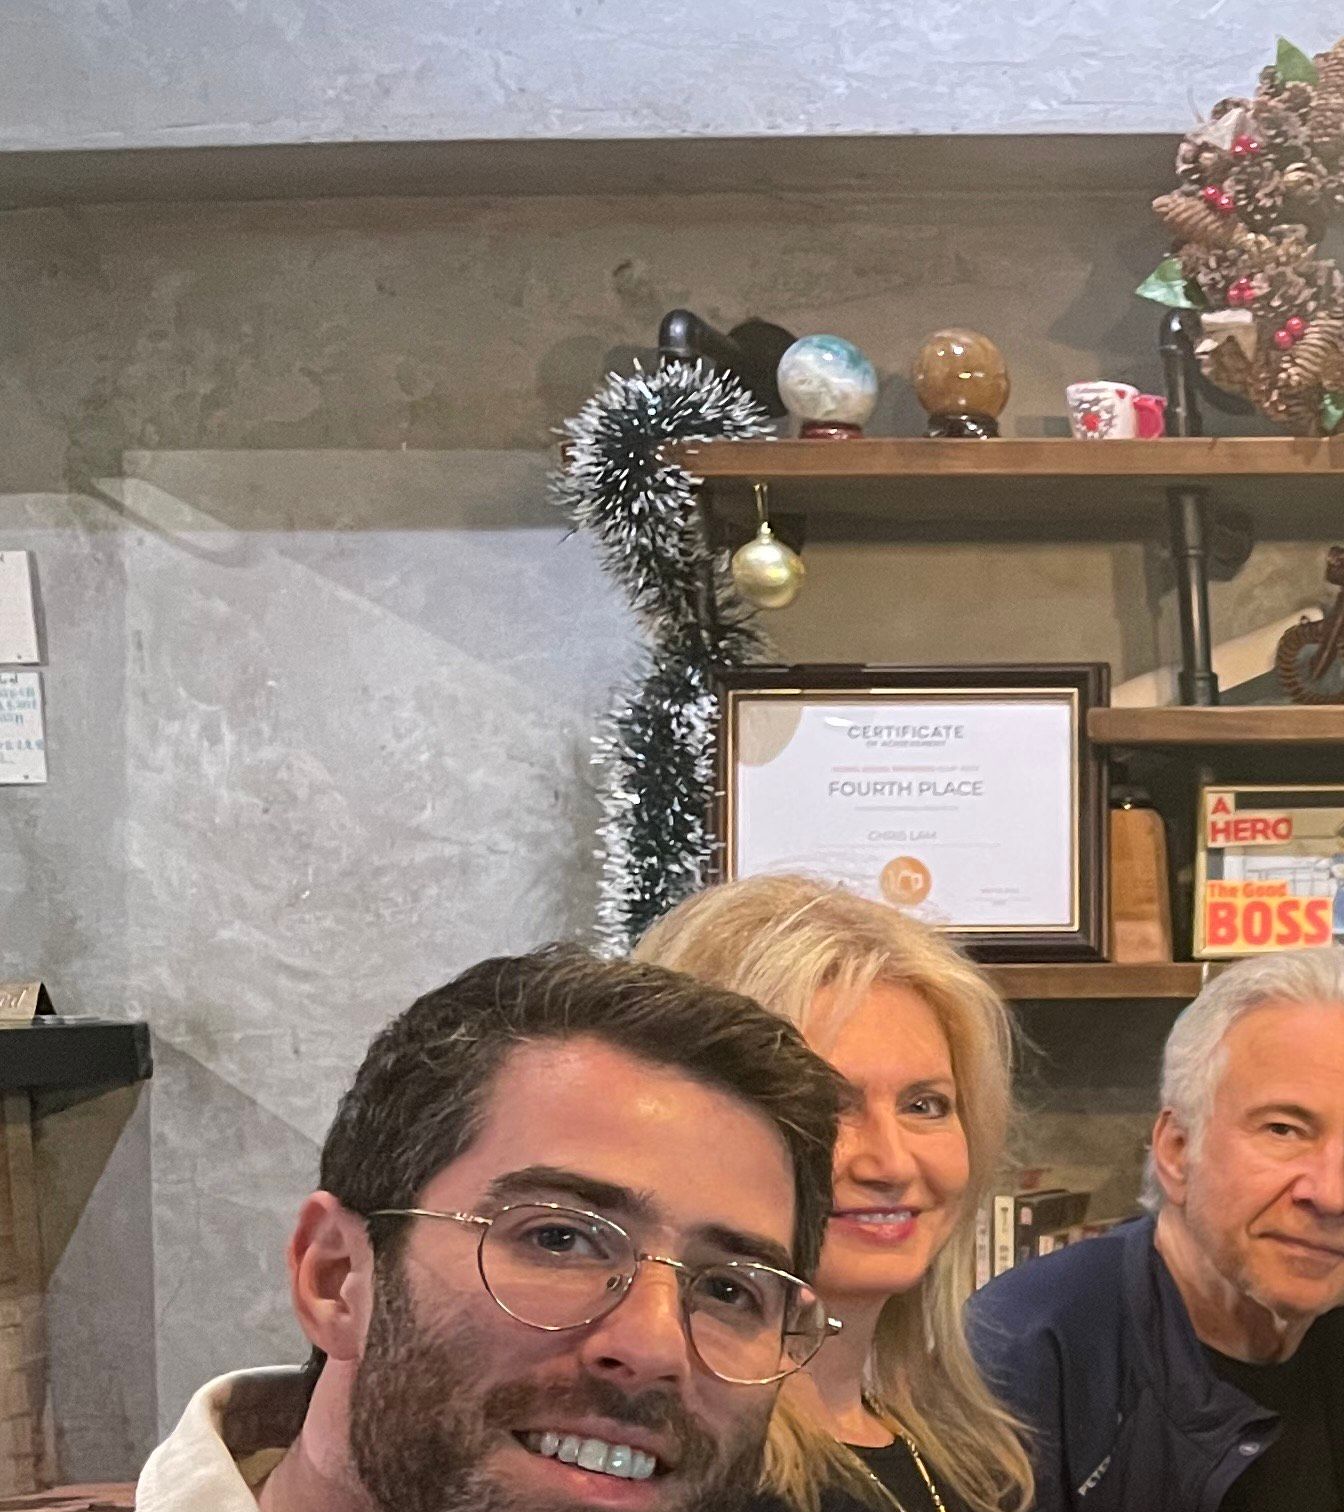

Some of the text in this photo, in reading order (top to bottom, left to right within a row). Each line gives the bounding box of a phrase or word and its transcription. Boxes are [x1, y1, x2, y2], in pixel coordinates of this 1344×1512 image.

[847, 724, 965, 740] CERTIFICATE
[828, 780, 984, 797] FOURTH PLACE
[1210, 796, 1231, 815] A
[1210, 816, 1294, 843] HERO
[1207, 900, 1330, 946] BOSS
